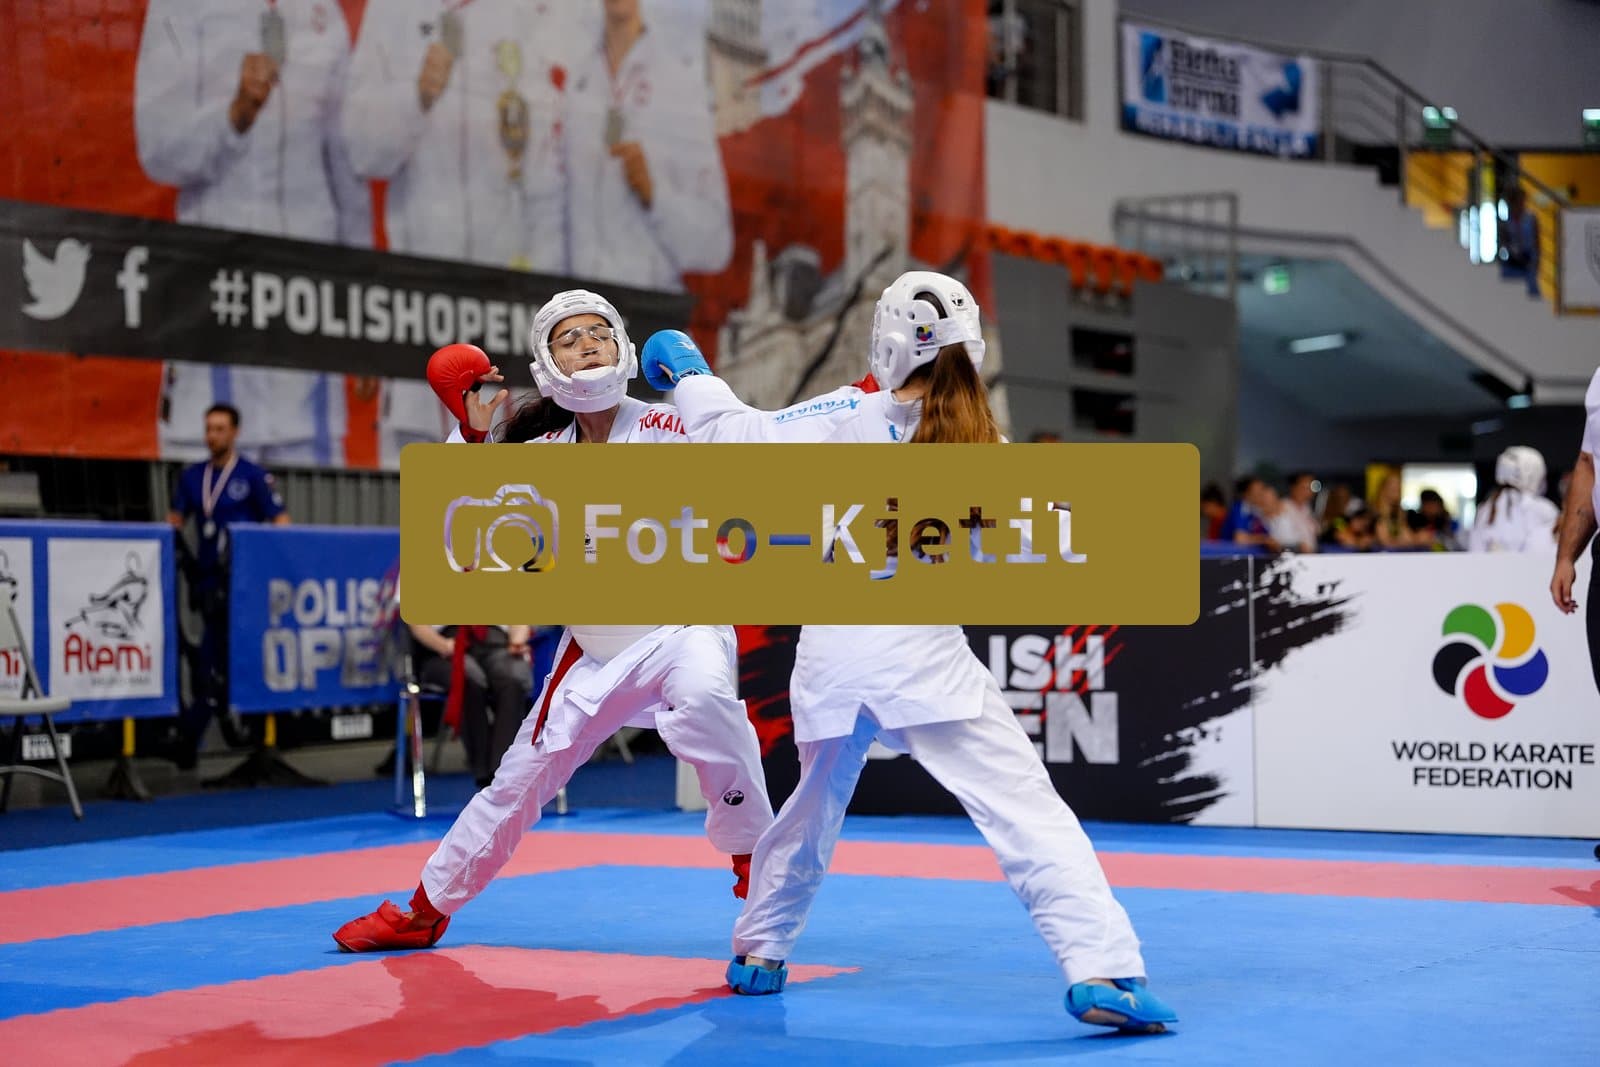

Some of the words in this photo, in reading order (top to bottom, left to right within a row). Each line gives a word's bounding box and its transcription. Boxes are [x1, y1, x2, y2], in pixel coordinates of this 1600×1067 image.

[64, 633, 152, 673] Atemi
[1392, 741, 1487, 762] WORLD
[1493, 743, 1595, 764] KARATE
[1413, 767, 1573, 789] FEDERATION
